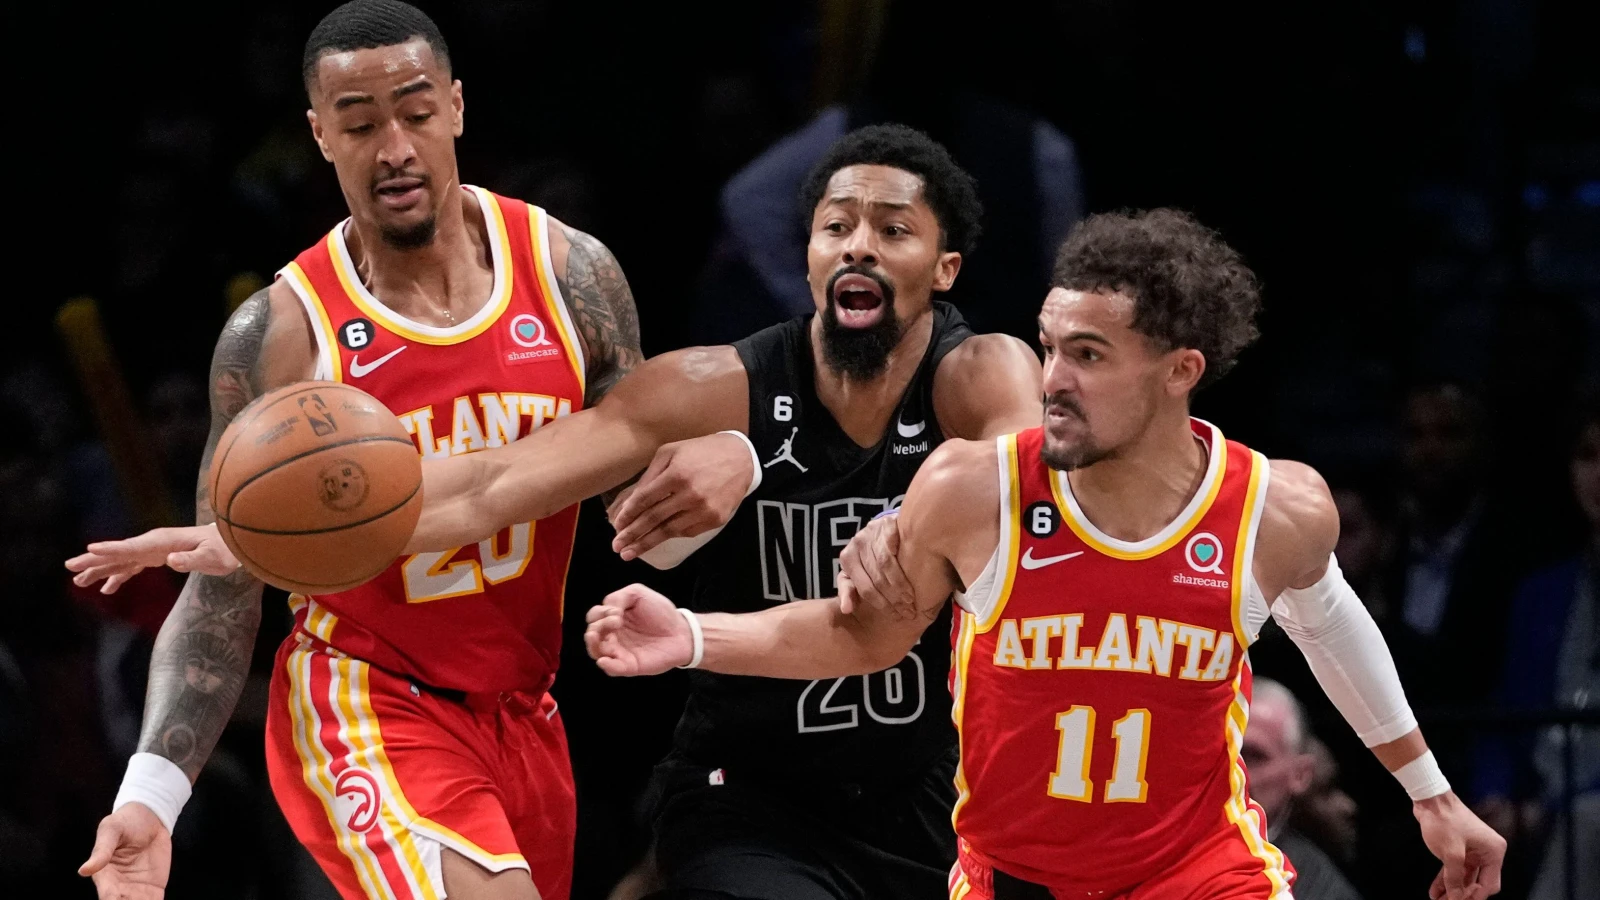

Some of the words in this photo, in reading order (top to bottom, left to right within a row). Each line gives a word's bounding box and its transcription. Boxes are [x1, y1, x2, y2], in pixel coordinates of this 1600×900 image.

[345, 322, 366, 348] 6
[508, 348, 559, 361] sharecare
[773, 395, 793, 422] 6
[893, 441, 928, 455] Webull
[1032, 506, 1052, 534] 6
[756, 494, 906, 601] NE
[1172, 573, 1229, 589] sharecare
[993, 612, 1235, 682] ATLANTA
[1047, 704, 1152, 804] 11
